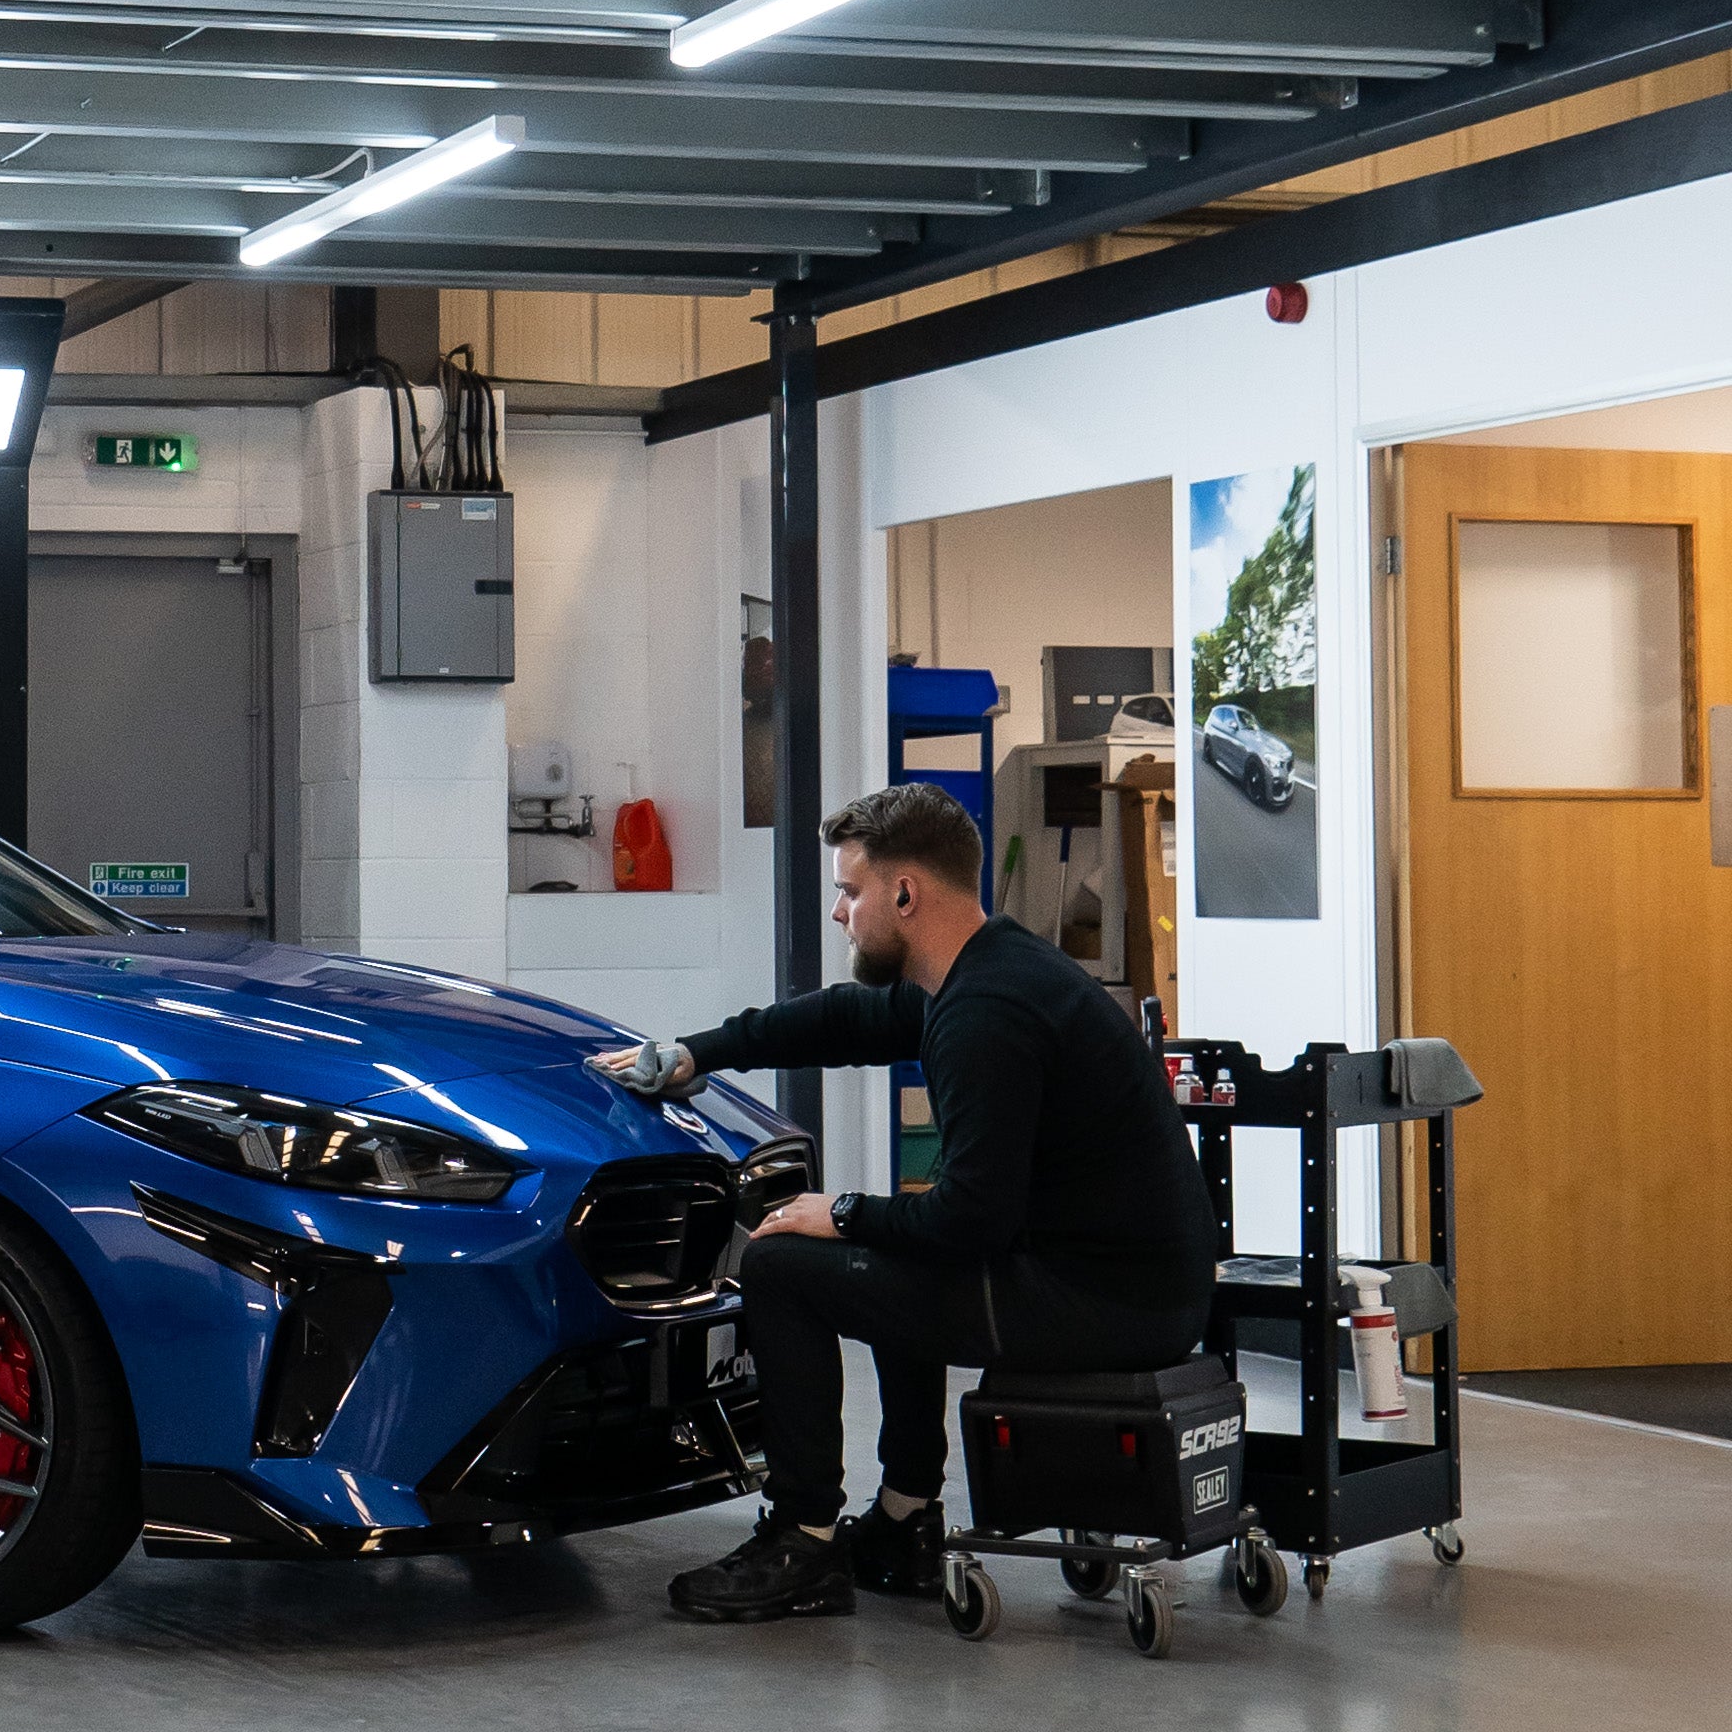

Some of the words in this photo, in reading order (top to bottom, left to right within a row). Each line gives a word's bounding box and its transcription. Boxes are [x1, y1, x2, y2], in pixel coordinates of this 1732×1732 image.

[118, 867, 145, 879] Fire
[150, 867, 176, 879] exit
[112, 882, 144, 895] Keep
[149, 882, 181, 893] clear
[1196, 1473, 1226, 1507] SEALEY
